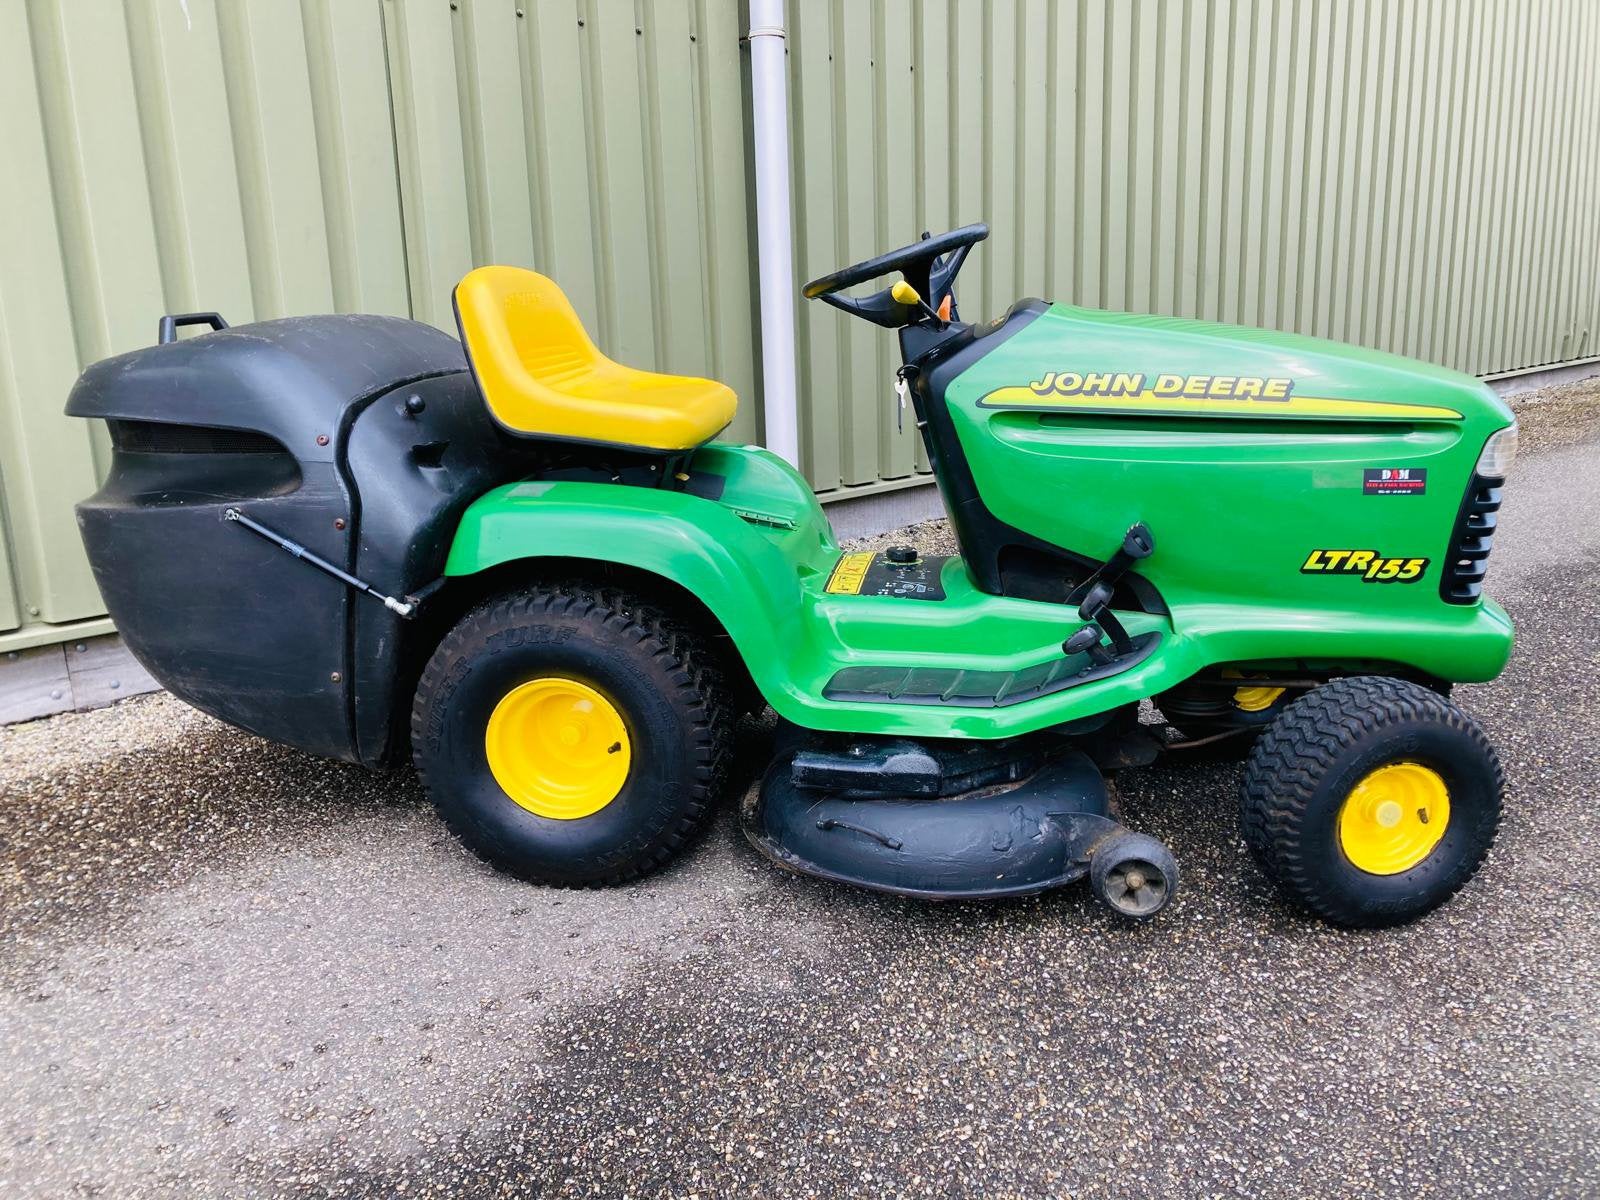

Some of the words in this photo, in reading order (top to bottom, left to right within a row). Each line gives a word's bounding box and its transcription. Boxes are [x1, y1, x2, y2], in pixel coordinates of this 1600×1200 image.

[1029, 372, 1146, 397] JOHN
[1152, 373, 1295, 402] DEERE
[486, 624, 578, 655] TURF
